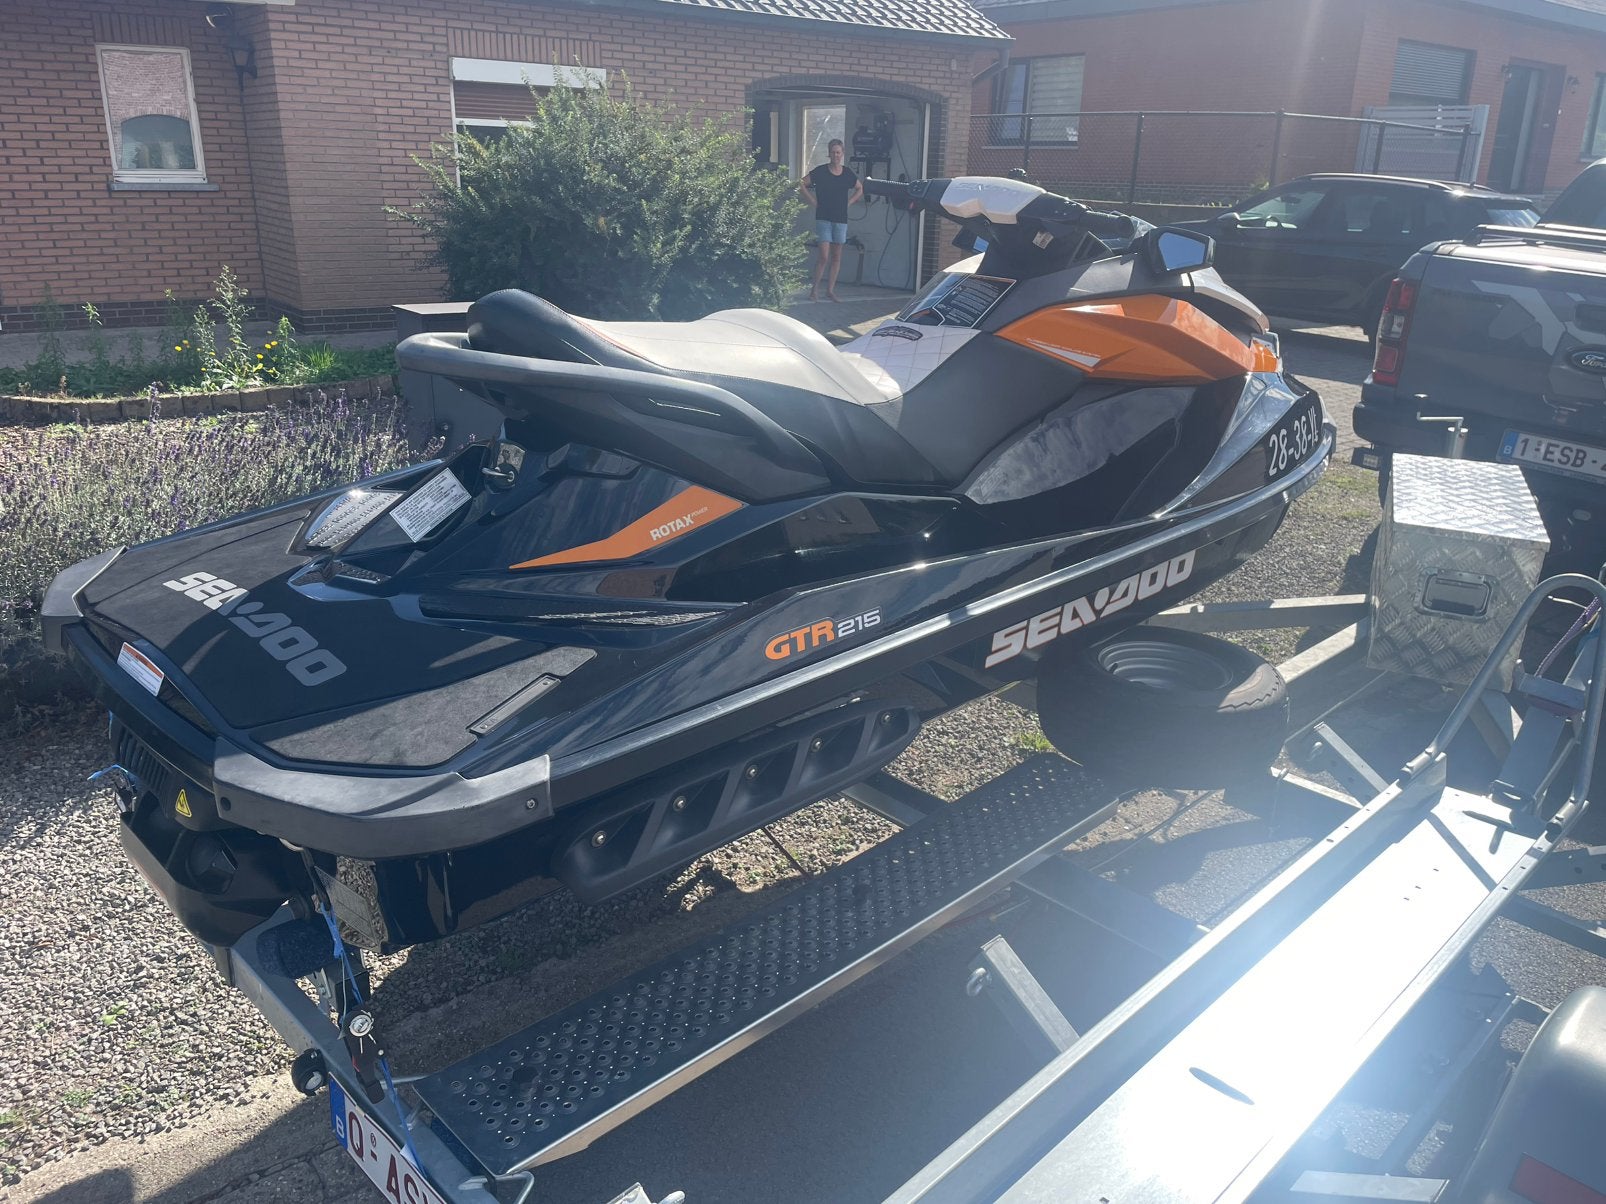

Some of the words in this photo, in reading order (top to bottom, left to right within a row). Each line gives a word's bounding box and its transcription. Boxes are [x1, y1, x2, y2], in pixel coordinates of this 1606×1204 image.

[1503, 445, 1513, 455] B
[649, 514, 694, 541] ROTAX
[765, 620, 835, 661] GTR
[838, 610, 881, 638] 215
